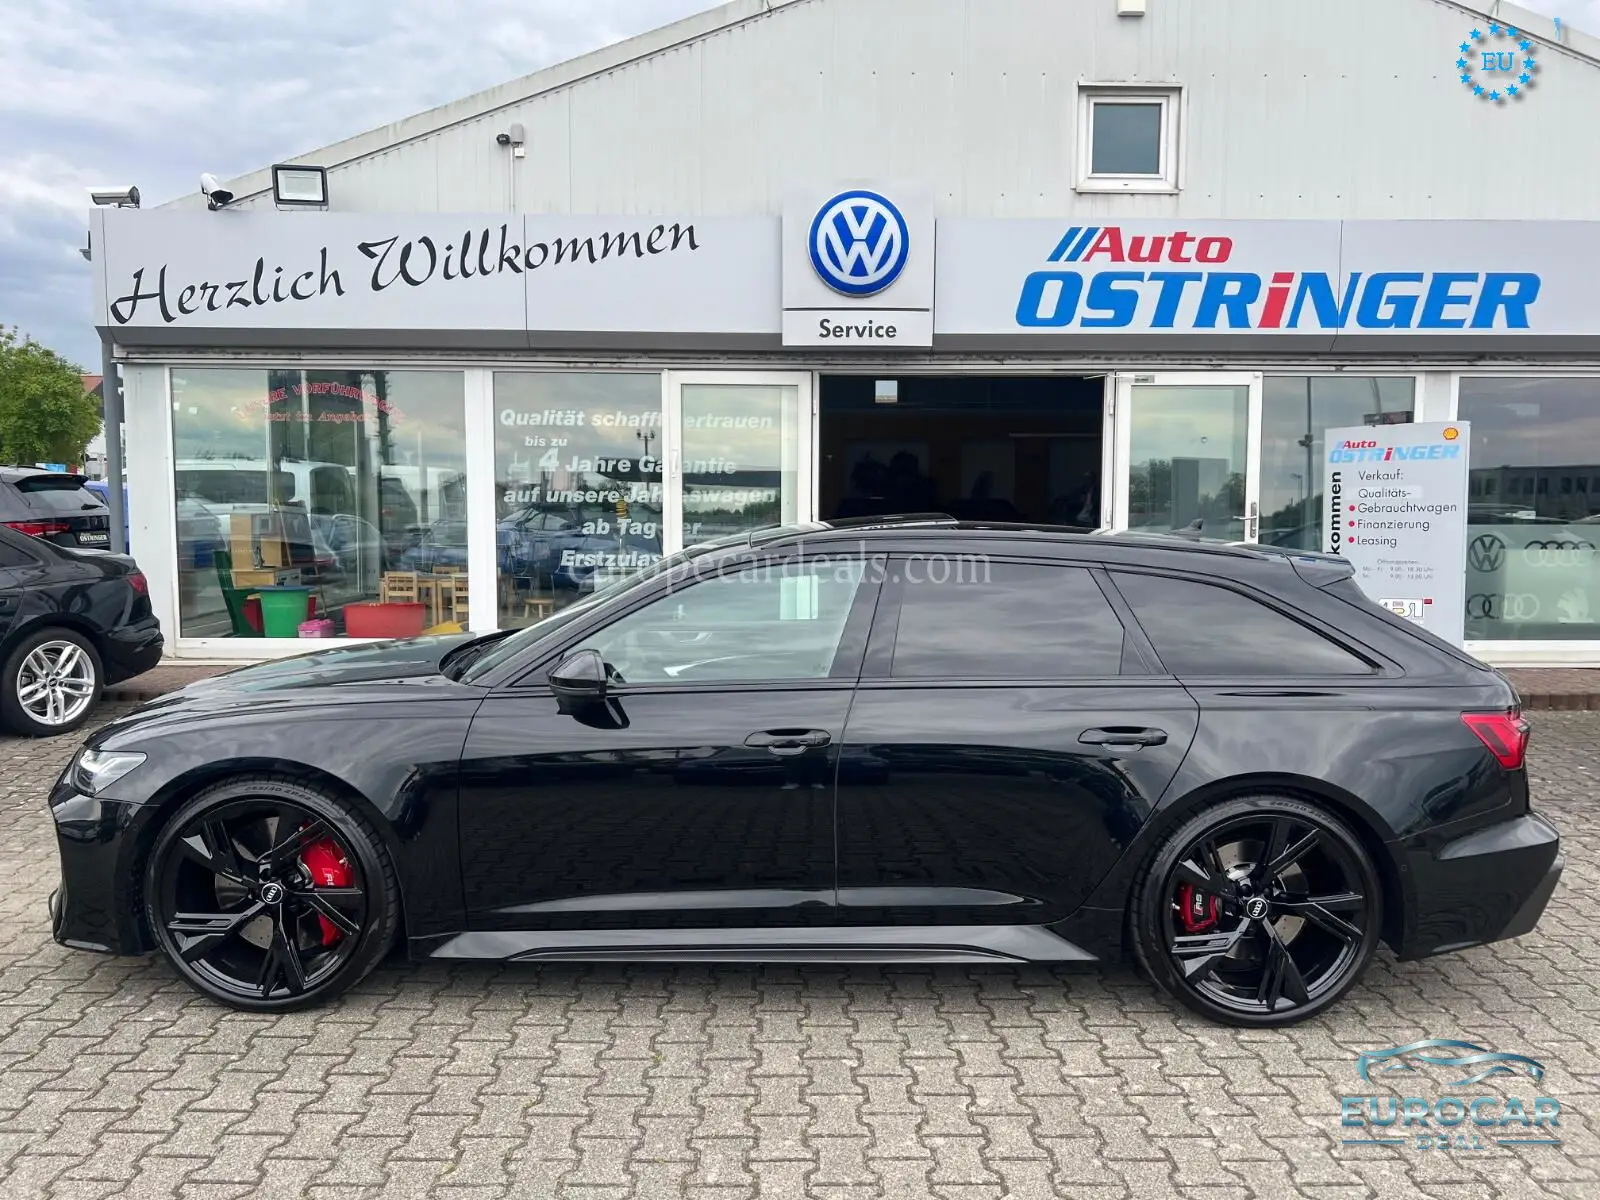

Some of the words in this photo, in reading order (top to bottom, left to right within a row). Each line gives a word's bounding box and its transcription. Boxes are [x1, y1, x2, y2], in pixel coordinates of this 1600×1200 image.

[1082, 227, 1233, 263] Auto
[110, 247, 345, 324] Herzlich
[357, 222, 700, 292] Willkommen
[818, 318, 897, 338] Service
[500, 409, 585, 427] Qualität
[591, 410, 663, 428] schafft
[682, 412, 773, 429] ertrauen
[525, 435, 546, 447] bis
[551, 439, 568, 448] zu
[1342, 440, 1377, 449] Auto
[538, 447, 560, 472] 4
[565, 456, 632, 473] Jahre
[638, 456, 737, 475] Gaantie
[1358, 468, 1404, 481] Verkauf:
[504, 488, 541, 504] auf
[546, 491, 624, 504] unsere
[625, 487, 776, 507] Jahswagen
[1358, 488, 1412, 499] Qualitäts-
[1357, 501, 1457, 515] Gebrauchtwagen
[582, 518, 611, 535] ab
[616, 518, 657, 540] Tag
[682, 521, 702, 535] er
[1357, 518, 1430, 531] Finanzierung
[1357, 535, 1398, 547] Leasing
